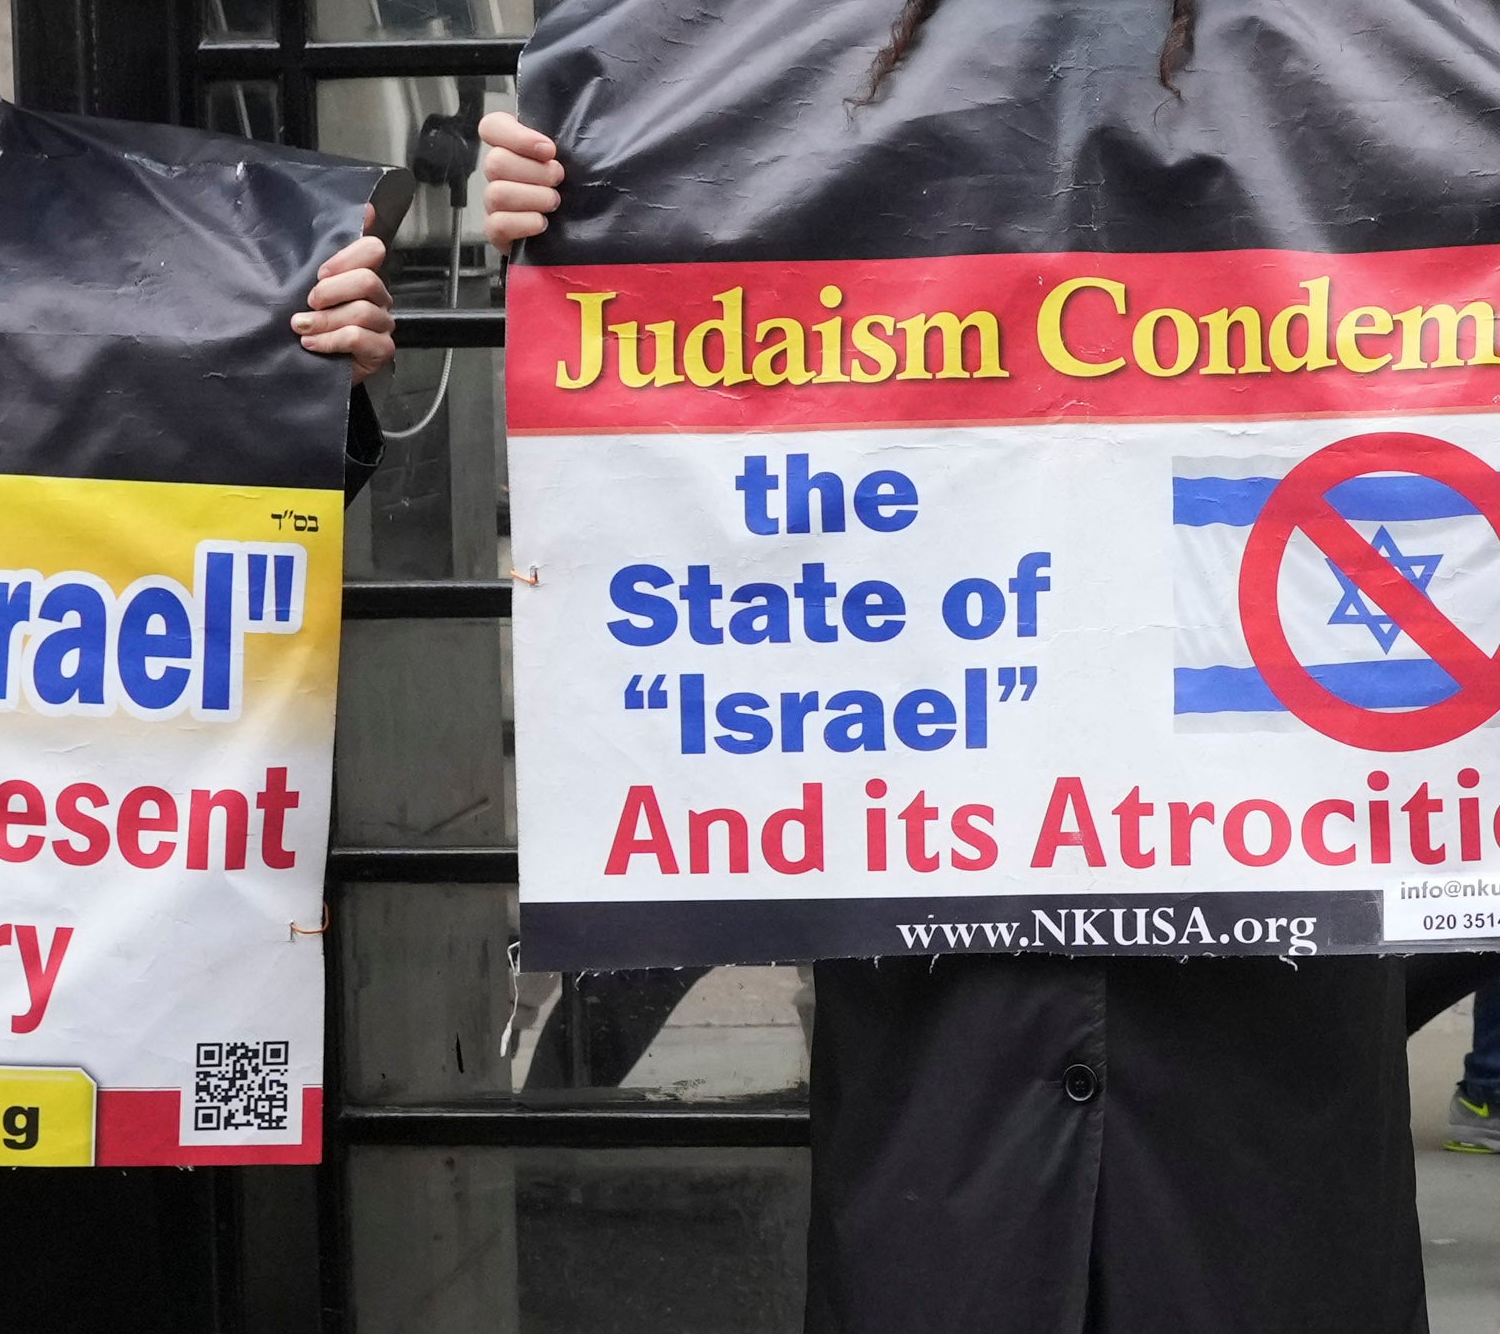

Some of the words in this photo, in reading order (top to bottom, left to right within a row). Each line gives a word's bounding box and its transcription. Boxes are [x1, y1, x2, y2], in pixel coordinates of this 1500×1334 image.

[557, 285, 1010, 389] Judaism
[735, 453, 920, 537] the
[607, 562, 907, 648] State
[941, 551, 1053, 641] of
[605, 782, 826, 876] And
[865, 778, 1000, 874] its
[896, 906, 1318, 956] www.NKUSA.org
[1423, 914, 1457, 931] 020
